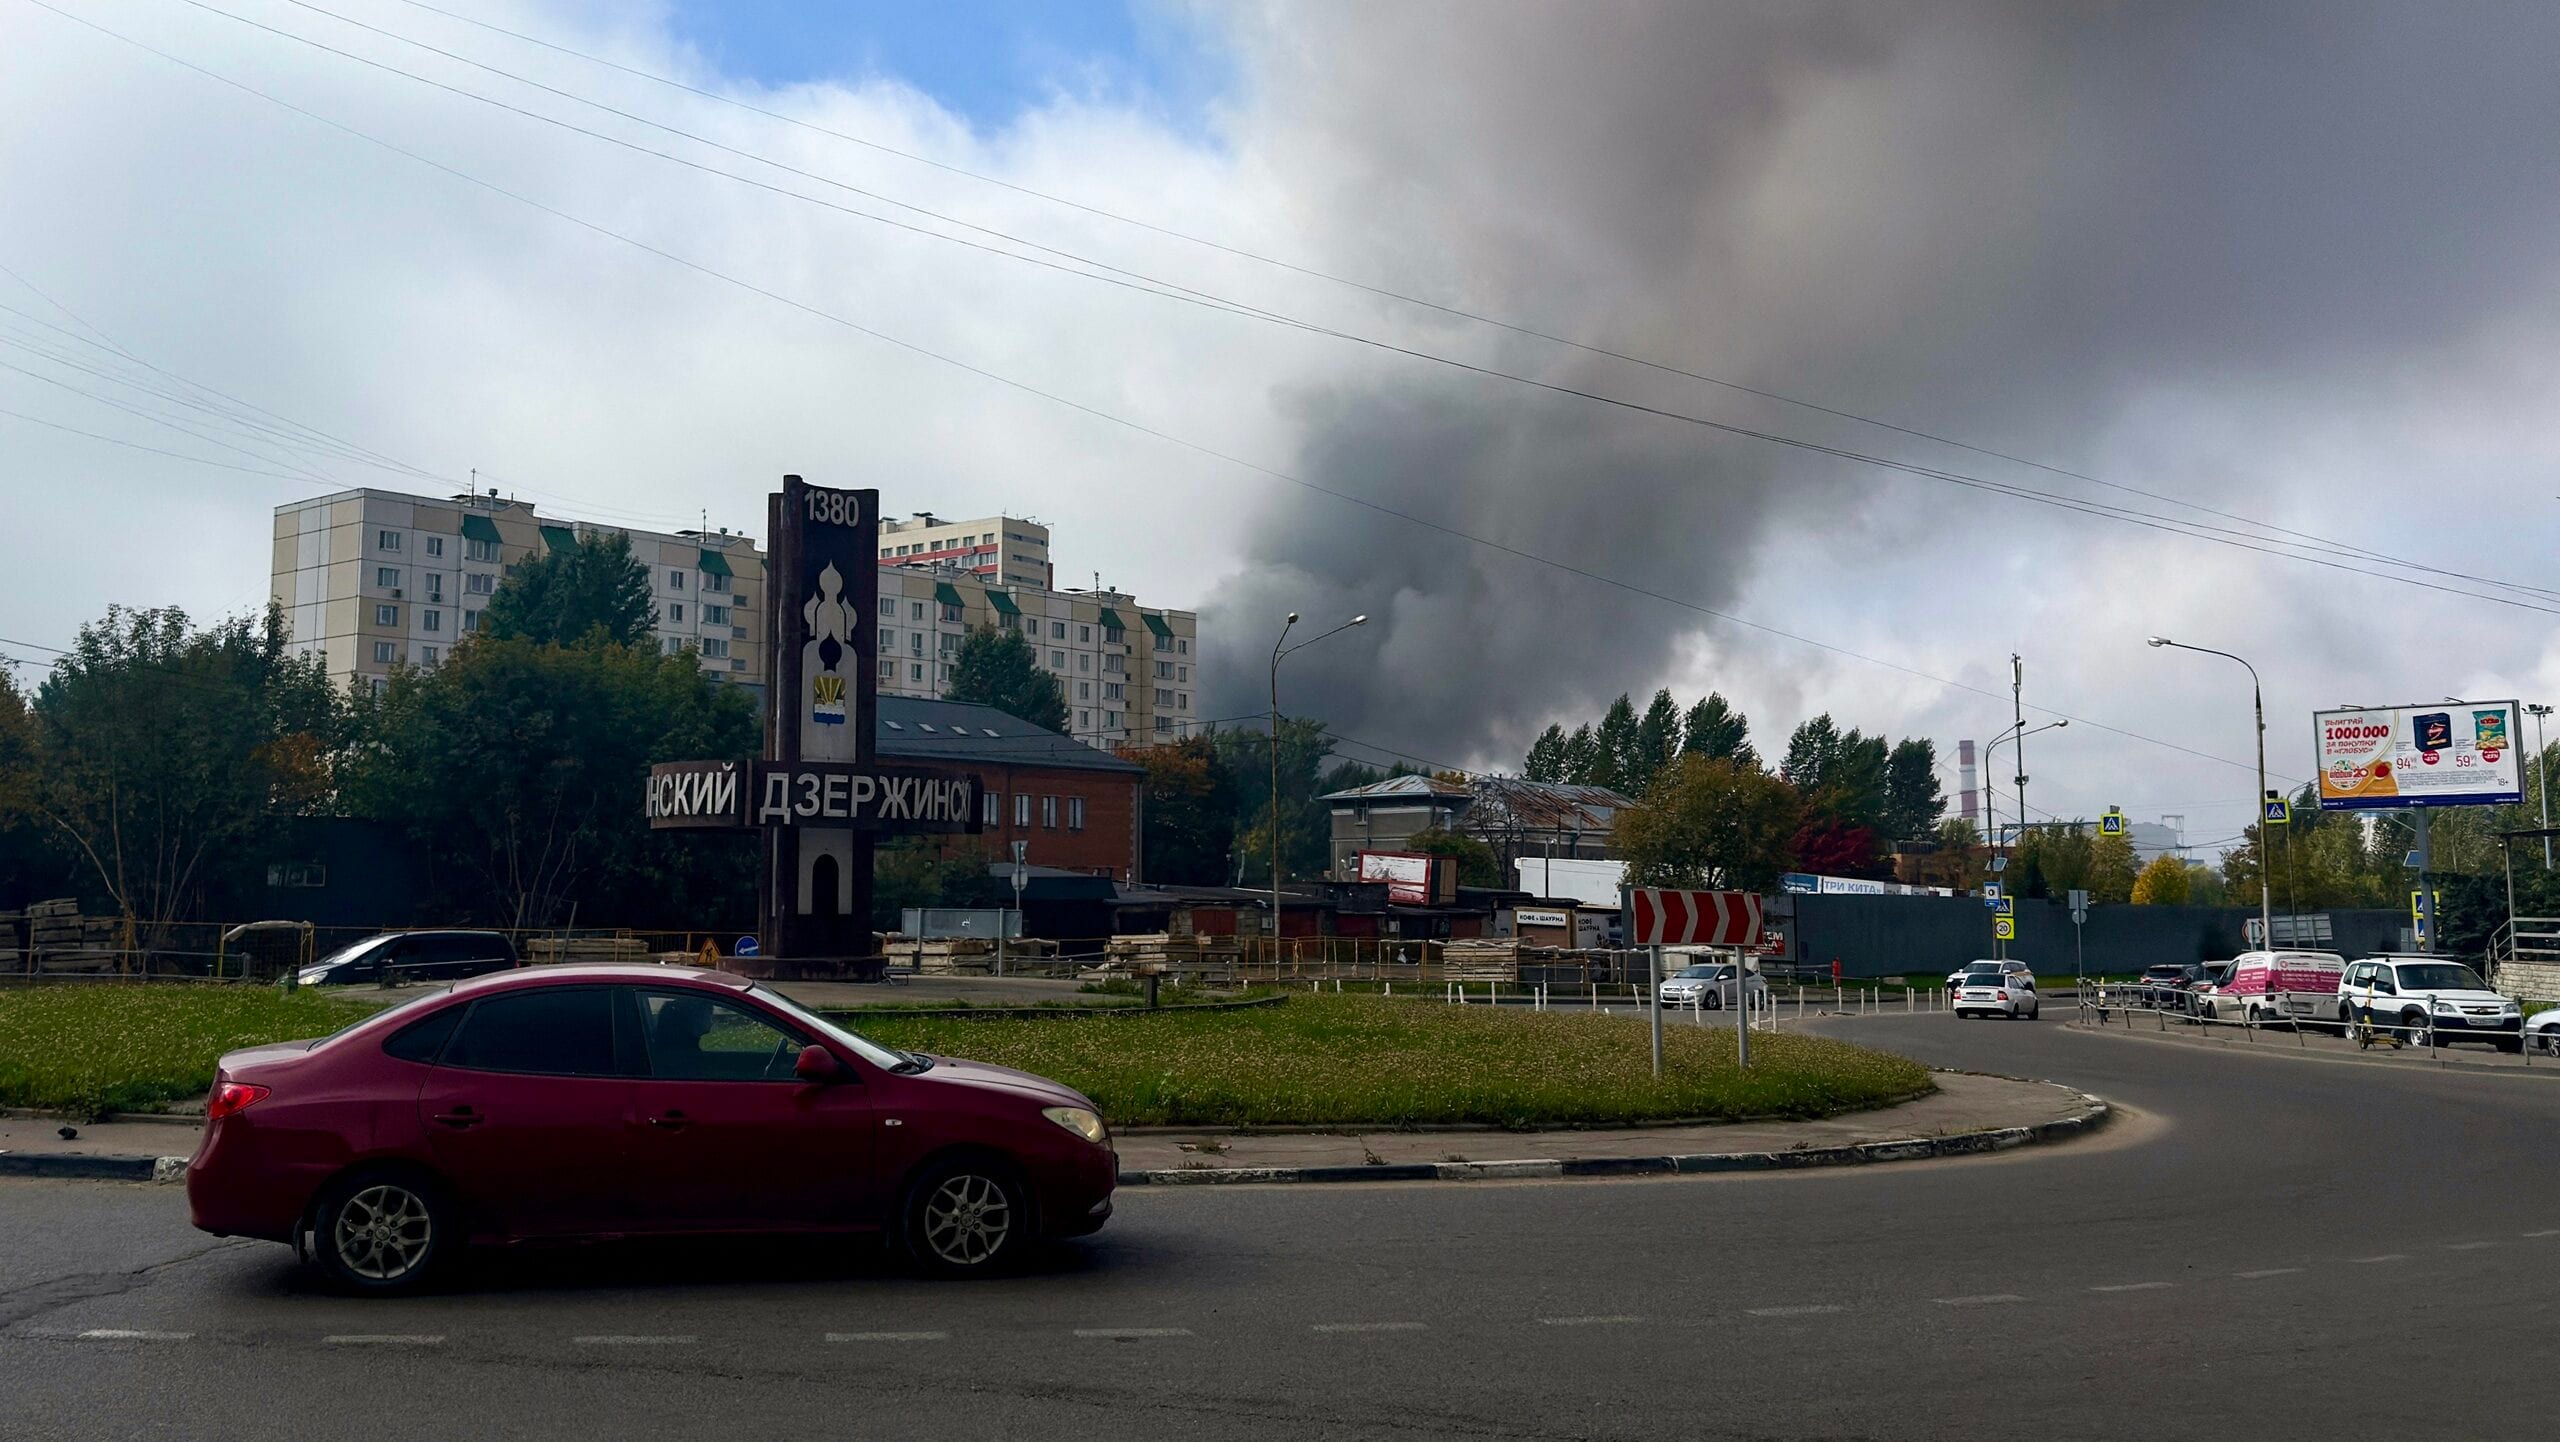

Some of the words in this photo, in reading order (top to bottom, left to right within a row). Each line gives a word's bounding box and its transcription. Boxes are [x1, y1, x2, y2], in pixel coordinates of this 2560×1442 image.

[804, 488, 859, 527] 1380
[2324, 716, 2364, 726] ВЫИГРАЙ
[2325, 726, 2361, 740] 1000
[2396, 757, 2411, 770] 94
[2456, 755, 2470, 767] 59
[759, 772, 972, 825] ДЗЕРЖИНСК
[1824, 880, 1845, 891] ТРИ
